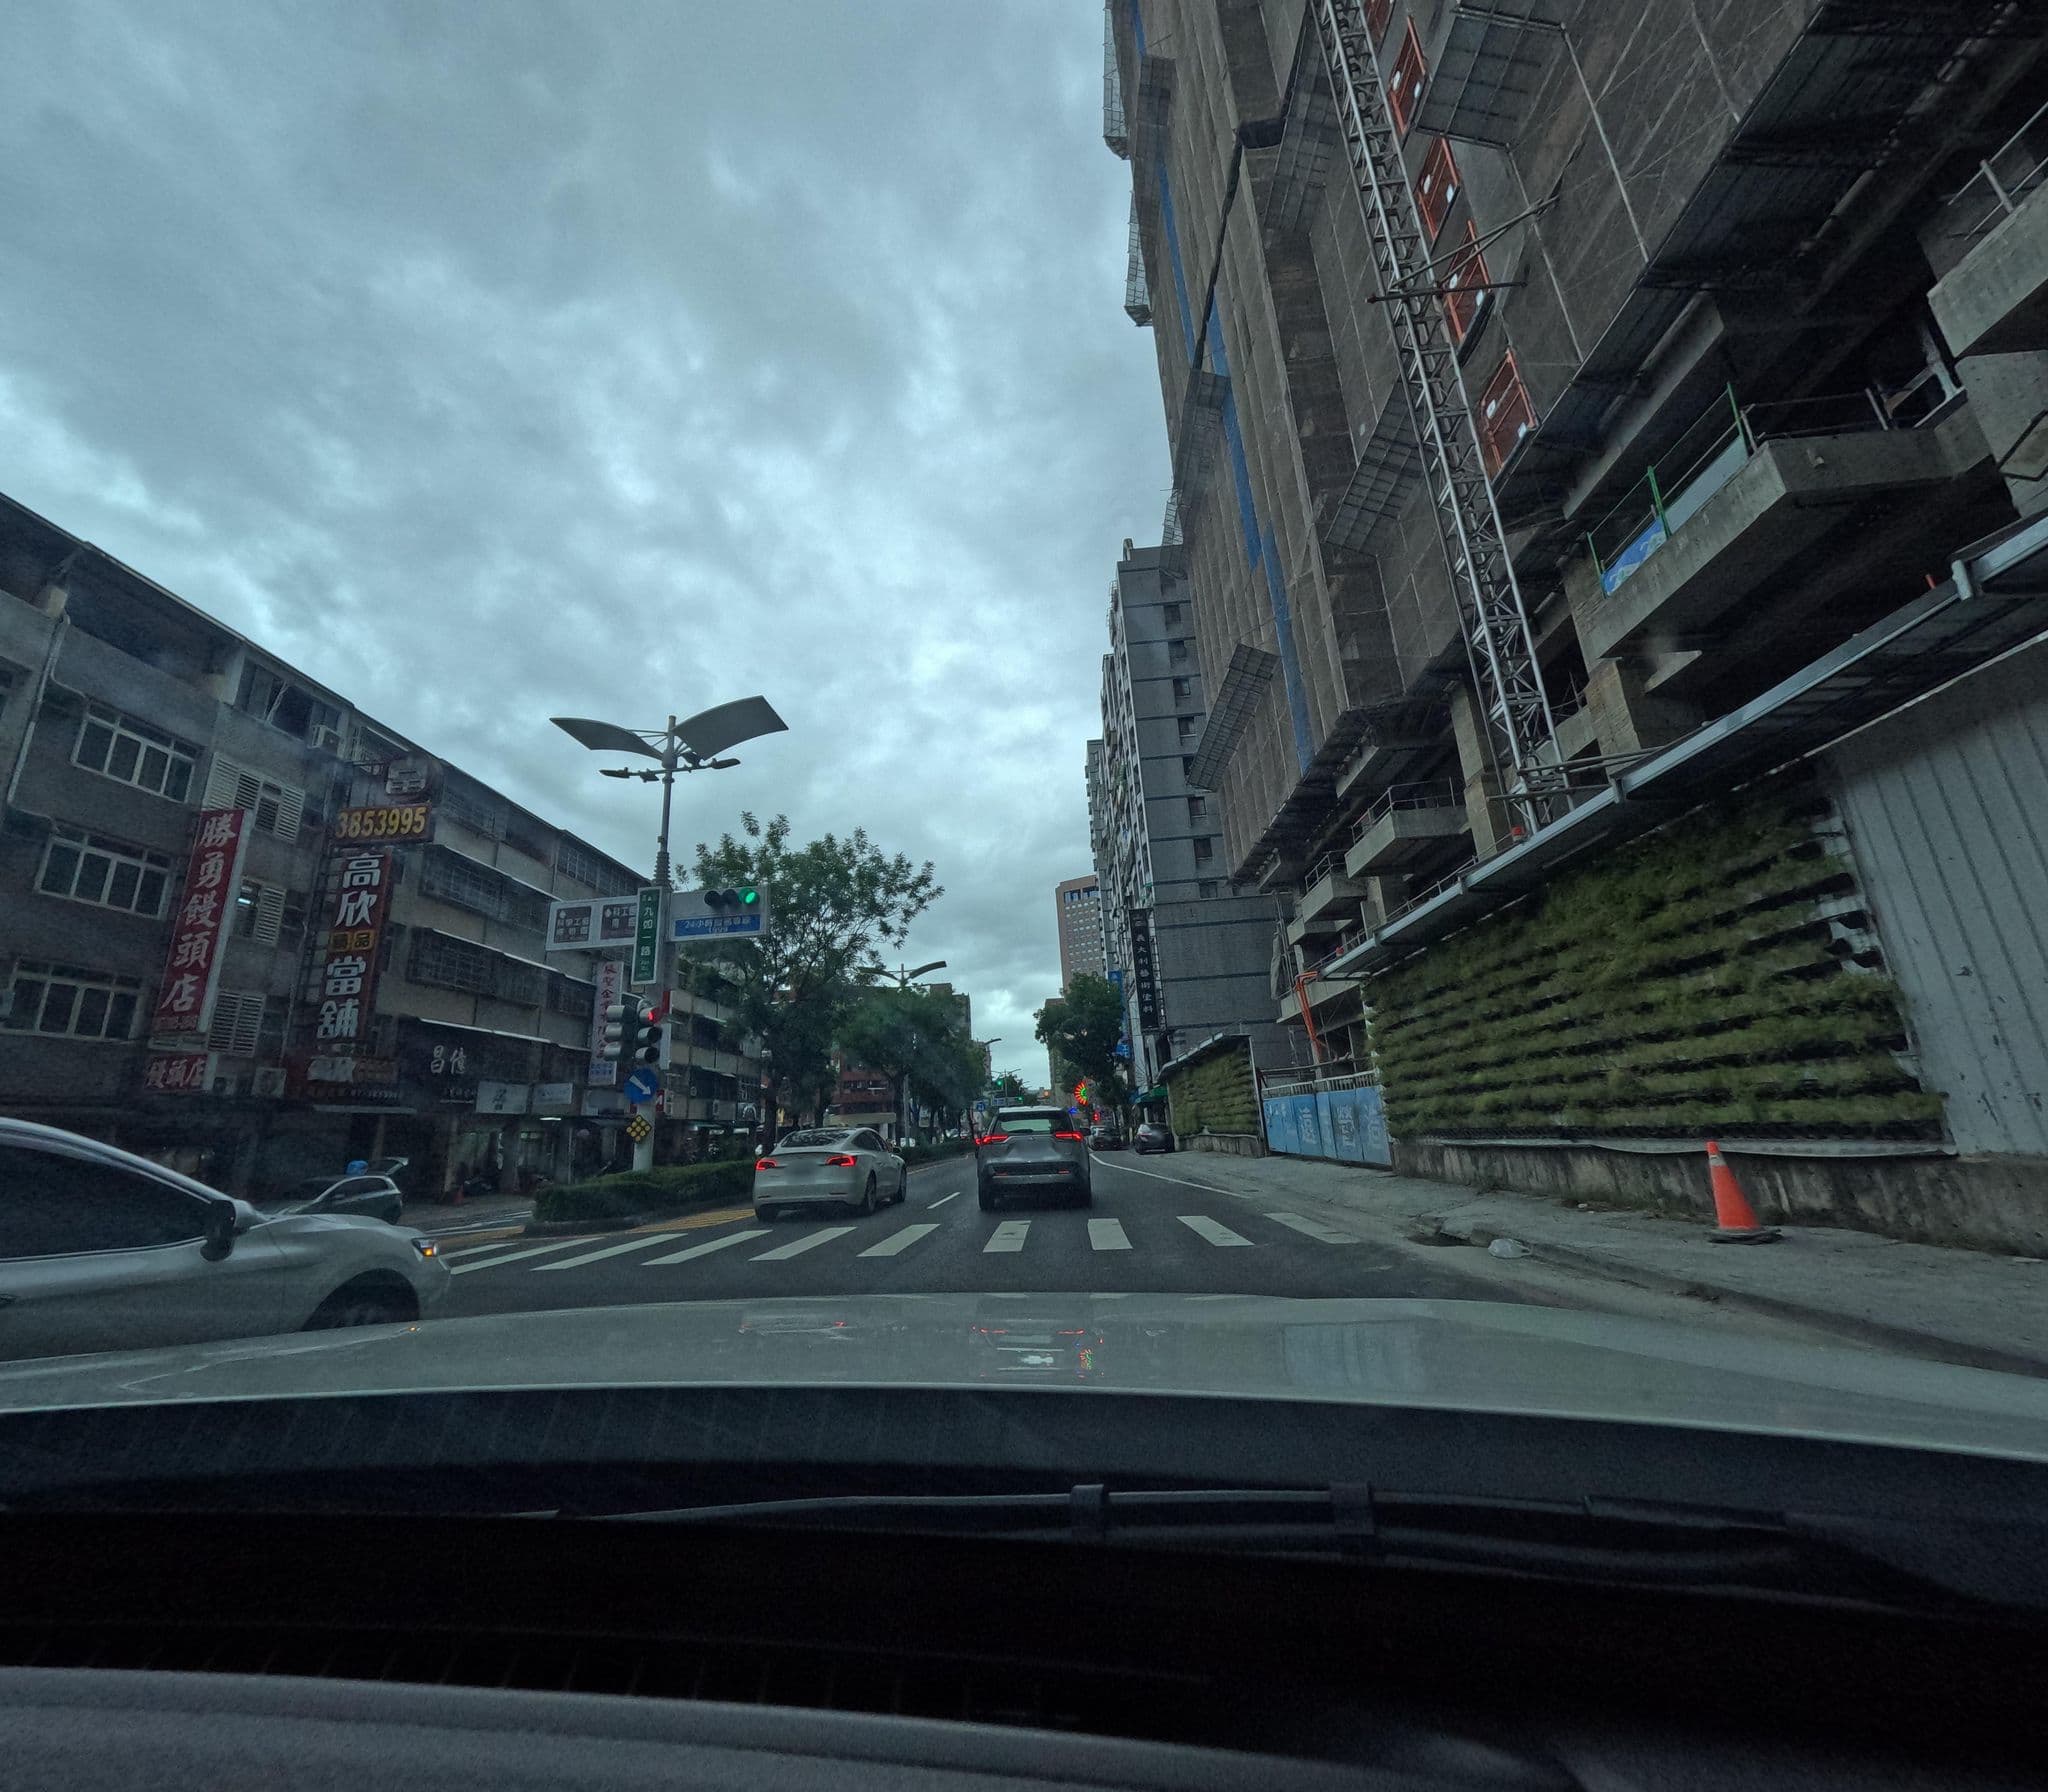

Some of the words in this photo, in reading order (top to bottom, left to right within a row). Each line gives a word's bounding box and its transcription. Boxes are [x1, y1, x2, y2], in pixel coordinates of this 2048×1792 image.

[335, 806, 427, 839] 3853995
[161, 813, 236, 1013] 勝勇饅頭店
